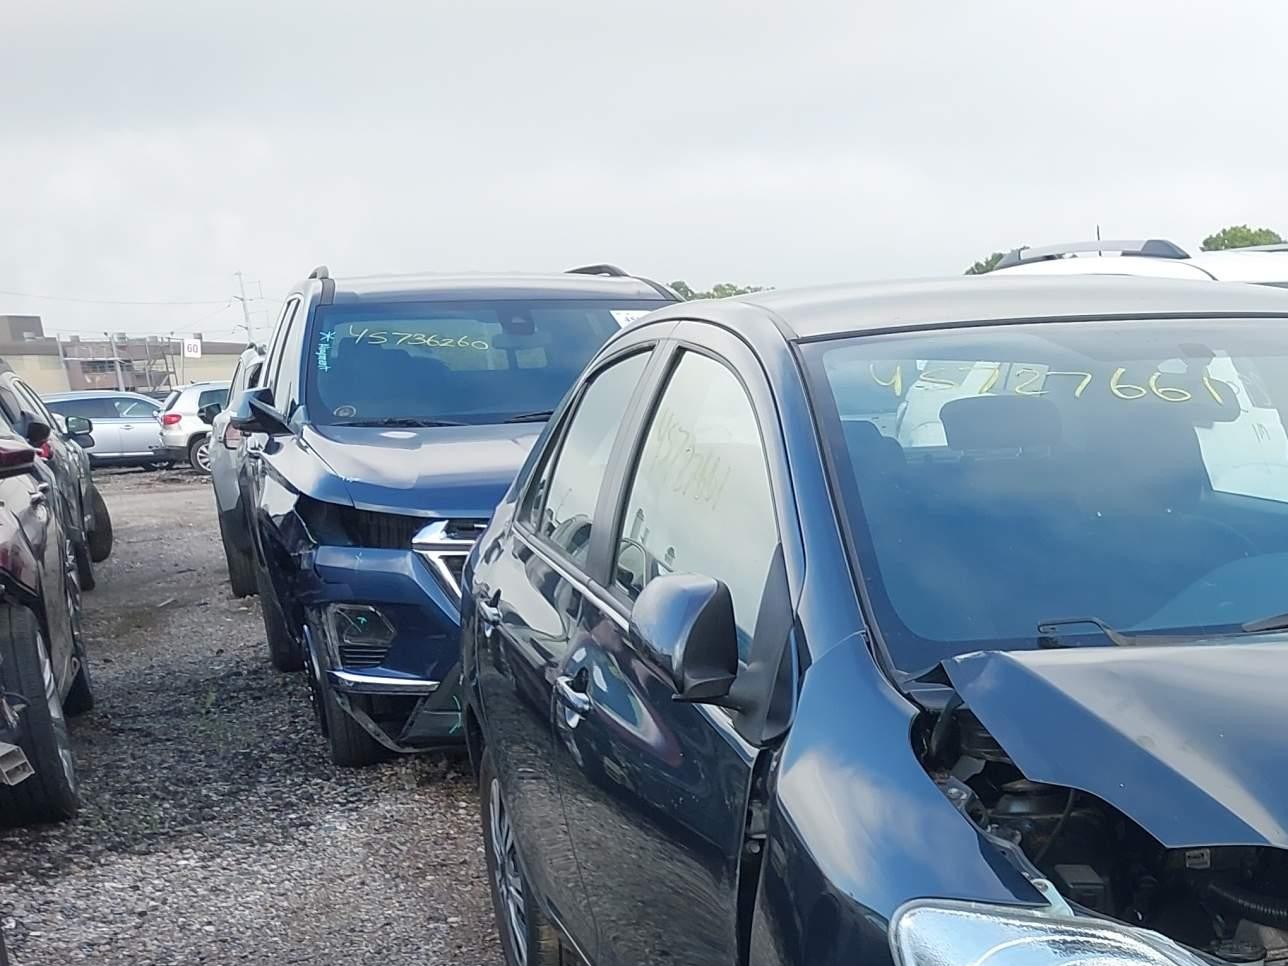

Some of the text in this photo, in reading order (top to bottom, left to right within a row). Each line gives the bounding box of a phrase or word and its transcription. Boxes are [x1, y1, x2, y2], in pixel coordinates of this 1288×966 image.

[187, 343, 199, 353] 60
[350, 325, 489, 350] 45736260
[870, 362, 1224, 406] 45727661
